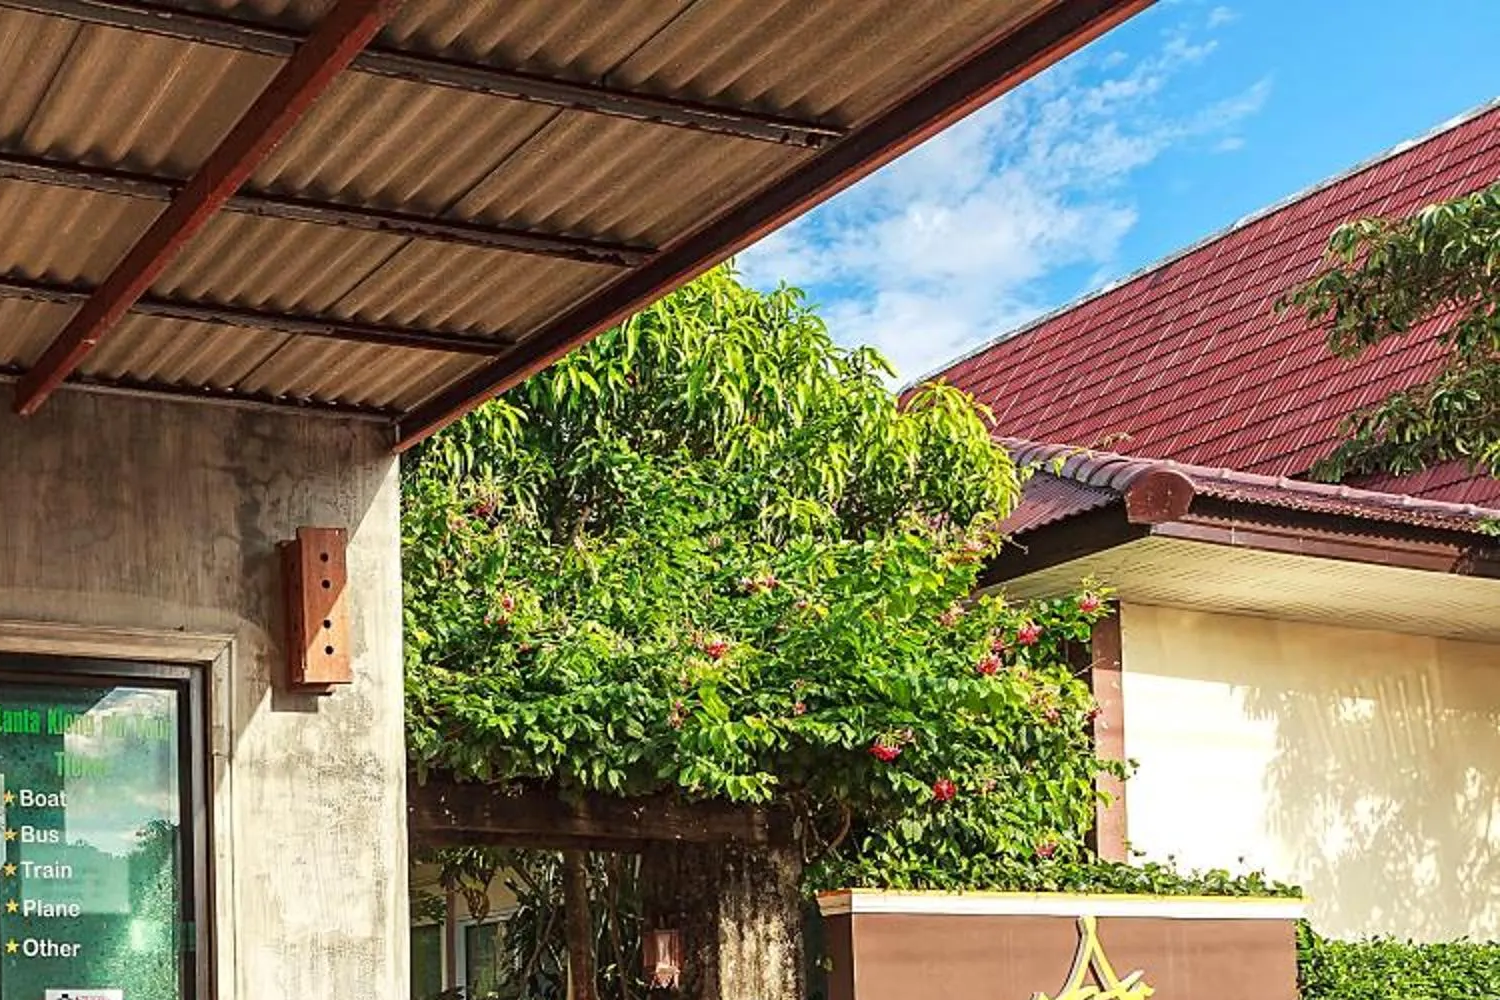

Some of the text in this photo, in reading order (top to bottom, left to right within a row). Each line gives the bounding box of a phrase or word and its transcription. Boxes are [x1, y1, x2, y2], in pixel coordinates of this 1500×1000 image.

[19, 789, 69, 808] Boat
[21, 825, 59, 843] Bus
[21, 861, 72, 879] Train
[23, 899, 80, 918] Plane
[22, 938, 81, 958] Other
